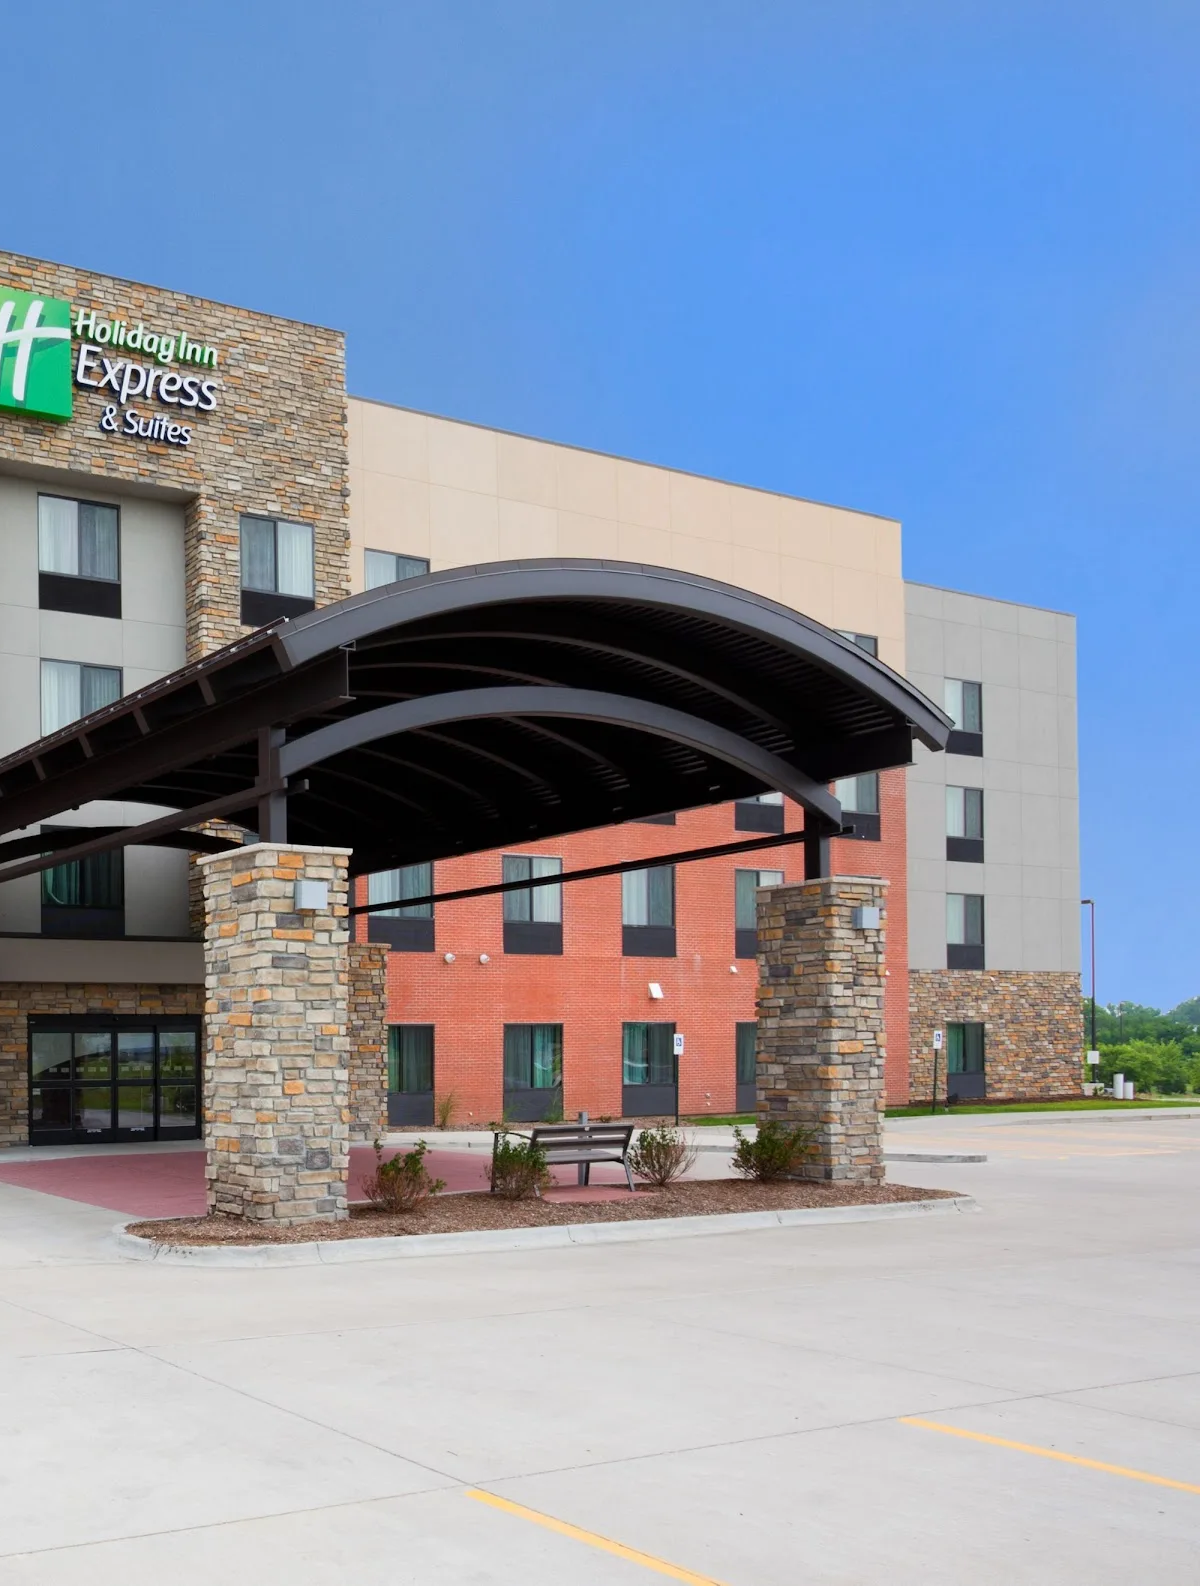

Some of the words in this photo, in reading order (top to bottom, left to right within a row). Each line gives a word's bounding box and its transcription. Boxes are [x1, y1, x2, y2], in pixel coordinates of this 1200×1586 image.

[74, 308, 175, 363] Holiday
[177, 331, 218, 367] Inn
[75, 343, 218, 411] Express
[101, 405, 119, 432] &
[123, 409, 193, 445] Suites
